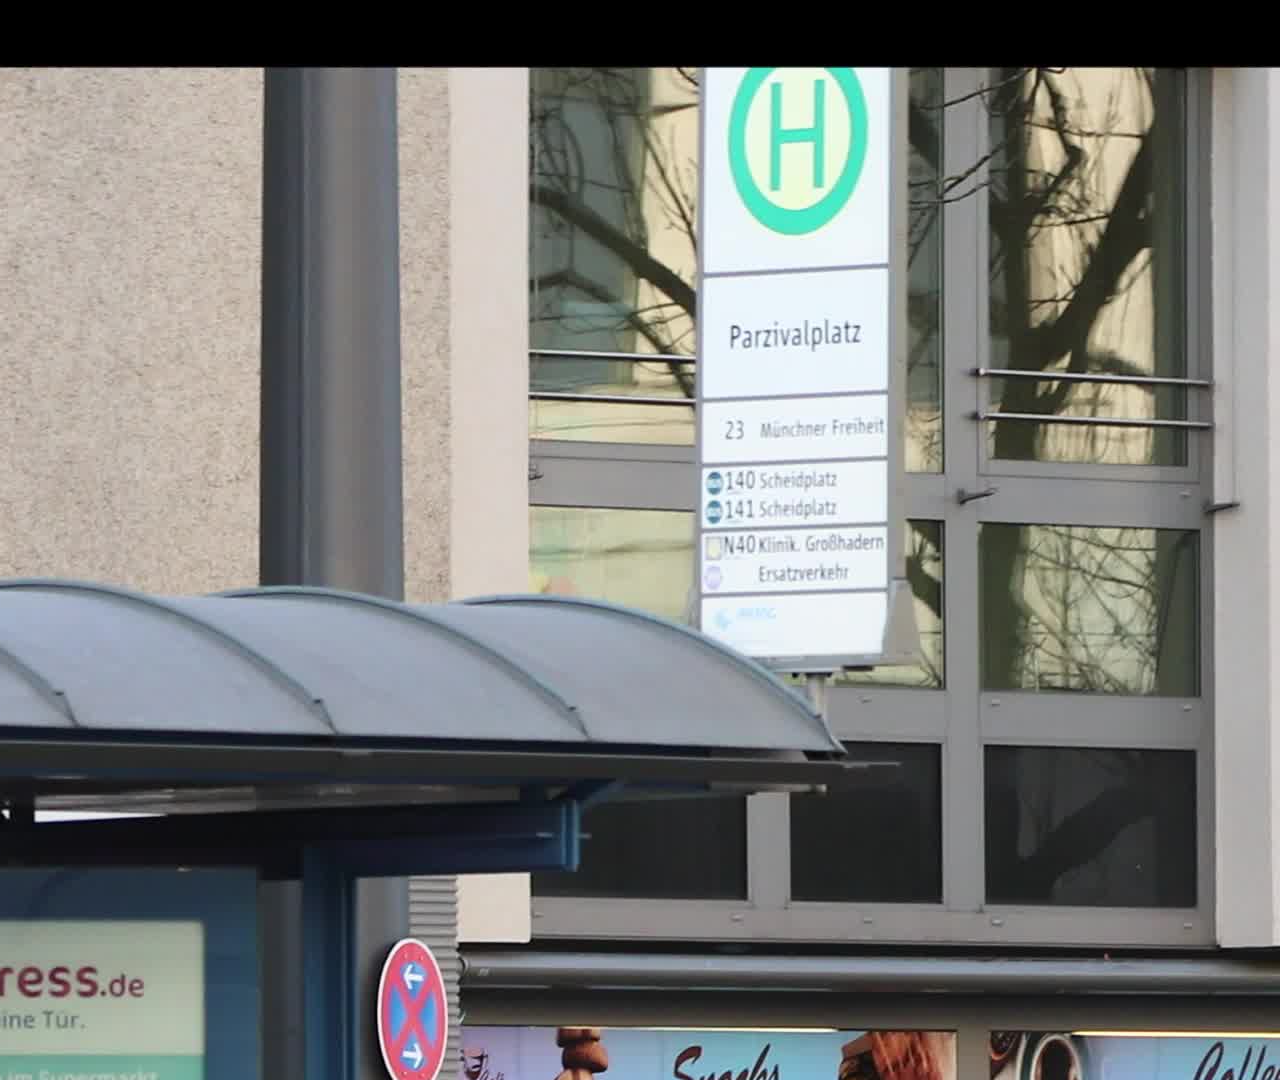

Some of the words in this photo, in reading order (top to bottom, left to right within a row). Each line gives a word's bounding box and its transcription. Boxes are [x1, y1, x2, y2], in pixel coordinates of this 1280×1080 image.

[730, 319, 862, 352] Parzivalplatz
[725, 420, 745, 440] 23
[760, 420, 827, 439] Münchner
[832, 416, 884, 436] Freiheit
[726, 471, 756, 491] 140
[759, 470, 837, 491] Scheidplatz
[726, 500, 754, 519] 141
[759, 499, 837, 519] Scheidplatz
[724, 535, 756, 555] N40
[806, 532, 884, 552] Großhadern
[759, 563, 849, 582] Ersatzverkehr
